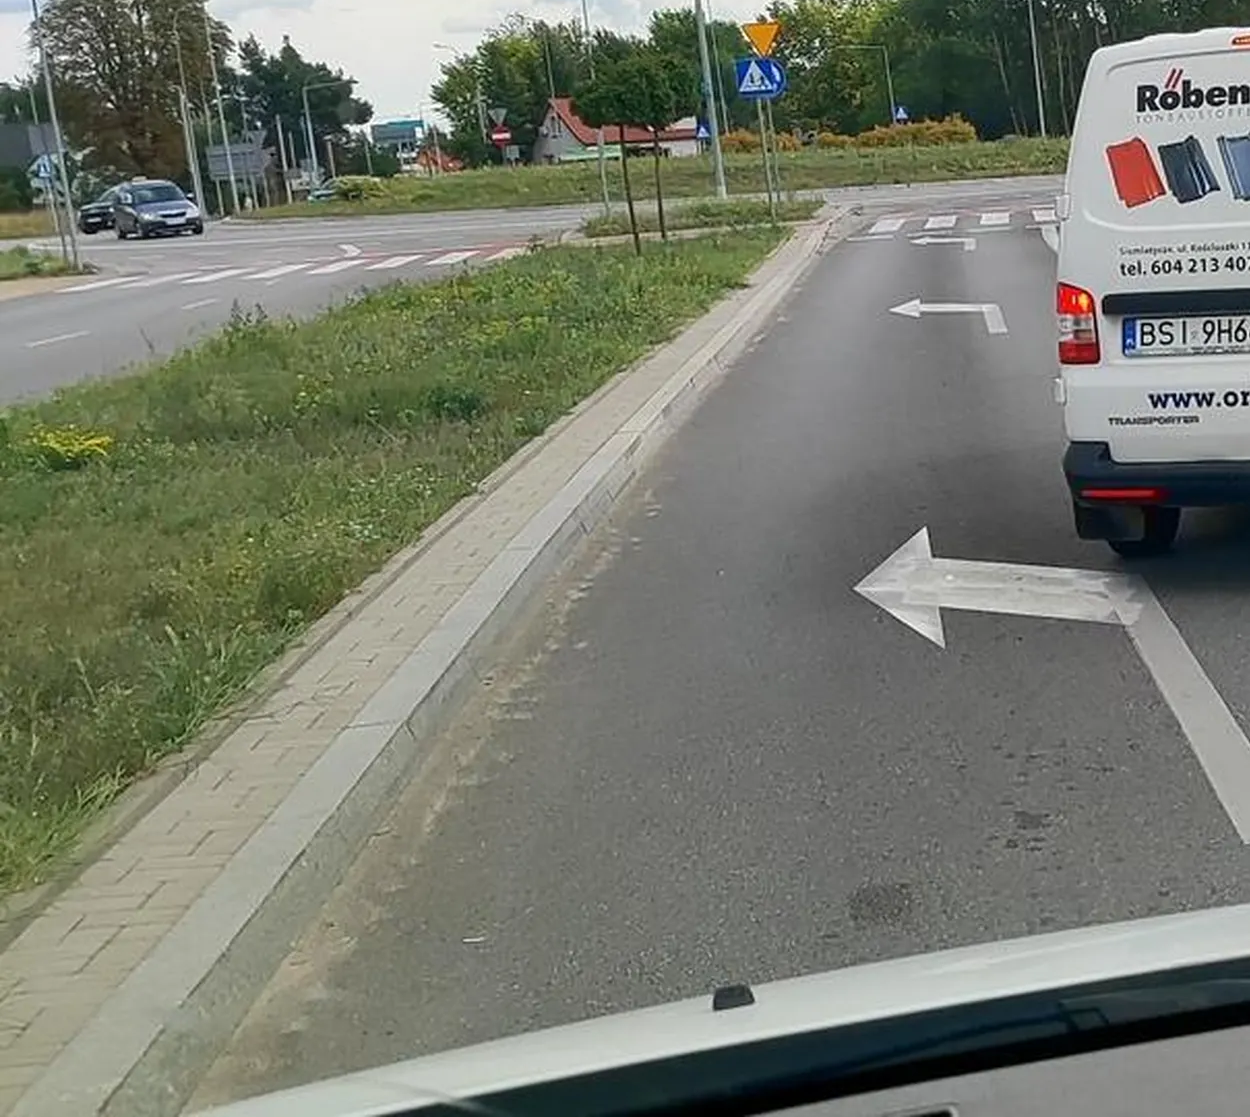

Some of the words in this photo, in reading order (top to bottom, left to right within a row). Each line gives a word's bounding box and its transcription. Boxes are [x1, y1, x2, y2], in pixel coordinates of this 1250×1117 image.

[1120, 260, 1147, 277] tel.
[1151, 259, 1183, 275] 604
[1188, 257, 1219, 273] 213
[1140, 321, 1187, 347] BSI
